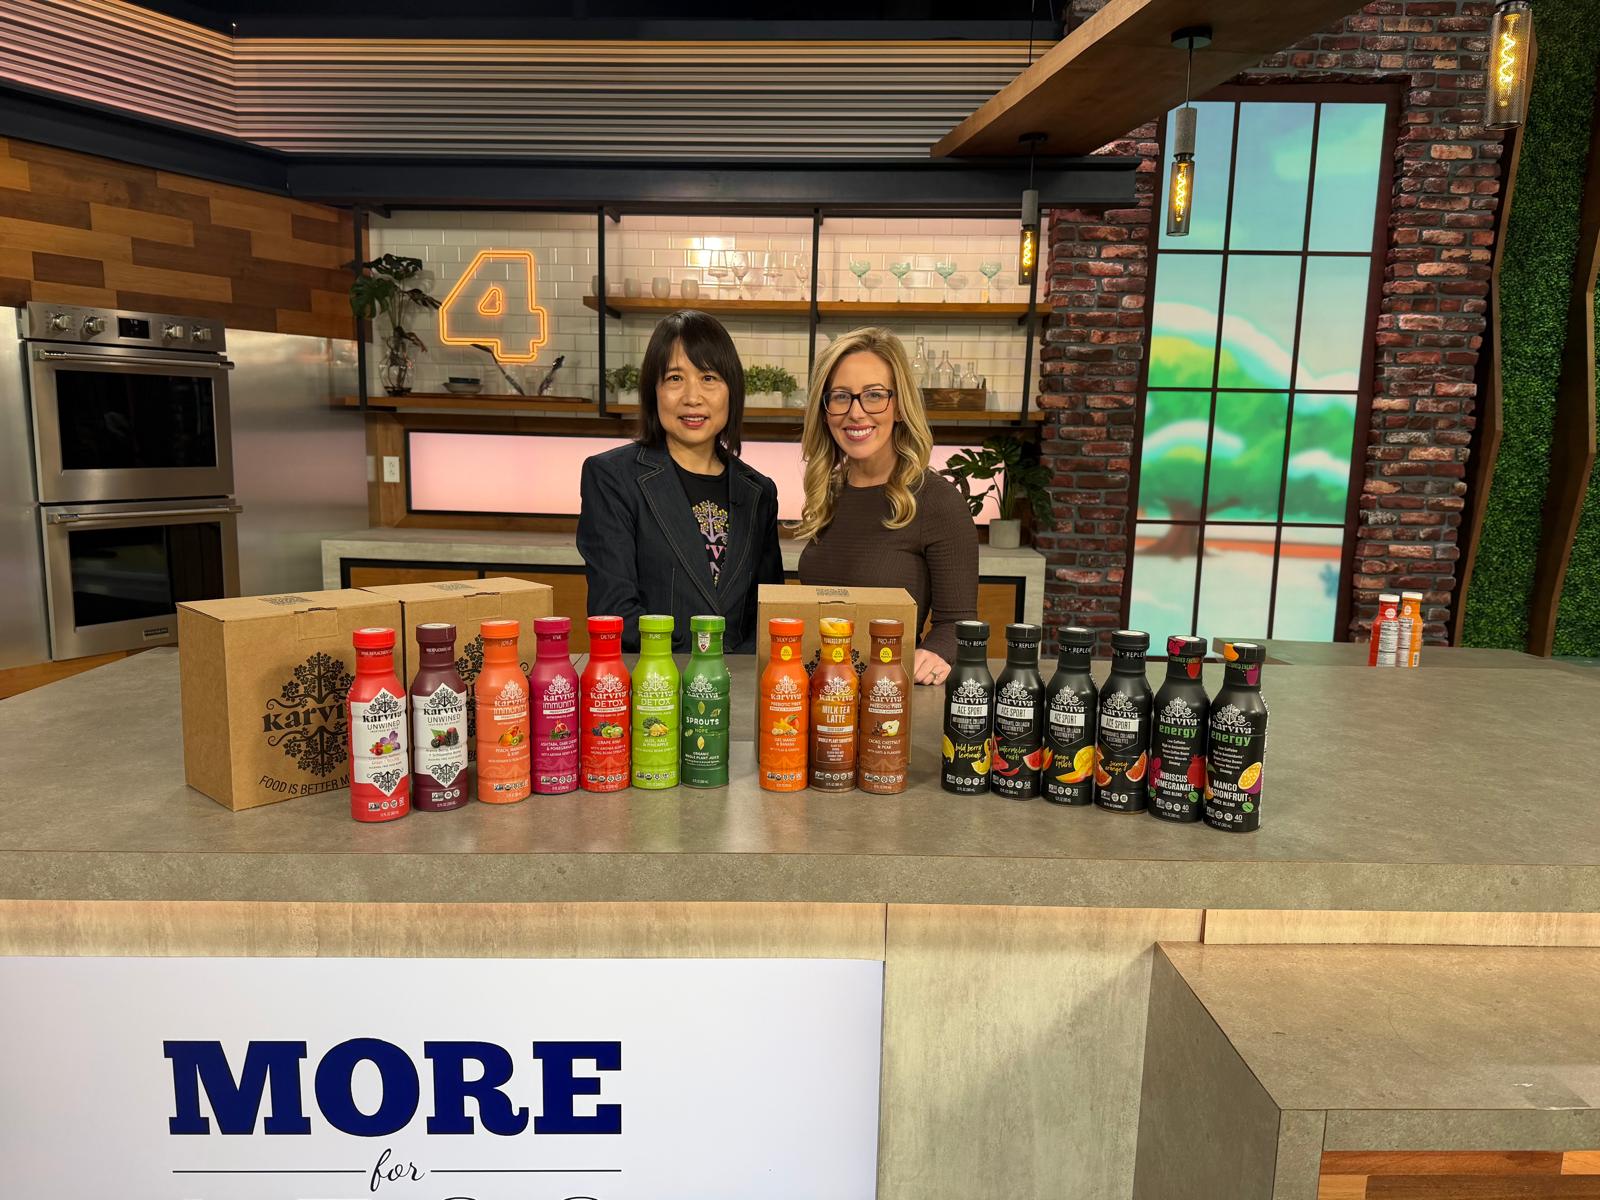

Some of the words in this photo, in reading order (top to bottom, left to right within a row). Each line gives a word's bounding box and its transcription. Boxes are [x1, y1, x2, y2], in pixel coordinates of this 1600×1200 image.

[439, 250, 547, 363] 4
[543, 691, 576, 701] karviva
[590, 691, 627, 700] karviva
[952, 695, 987, 703] karviva
[998, 695, 1033, 706] karviva
[594, 700, 624, 708] DETOX
[641, 698, 671, 706] DETOX
[1051, 703, 1085, 712] karviva
[424, 705, 462, 715] karviva
[822, 705, 838, 714] MILK
[840, 705, 850, 714] TEA
[957, 706, 967, 714] ACE
[967, 706, 983, 715] SPORT
[1001, 706, 1009, 716] ACE
[1010, 707, 1026, 717] SPORT
[1102, 707, 1138, 718] karviva
[262, 703, 346, 732] karvi
[362, 711, 402, 723] karviva
[428, 714, 460, 723] UNWINED
[686, 716, 720, 725] SPROUTS
[826, 714, 846, 723] LATTE
[1054, 714, 1062, 723] ACE
[1062, 715, 1077, 724] SPORT
[1160, 714, 1197, 726] karviva
[367, 720, 400, 730] UNWINED
[1106, 718, 1114, 727] ACE
[1114, 719, 1131, 728] SPORT
[1212, 720, 1252, 734] karviva
[1159, 724, 1197, 738] energy
[1210, 730, 1251, 747] energy
[1160, 771, 1188, 783] HIBISCUS
[259, 776, 287, 792] FOOD
[288, 784, 298, 794] IS
[301, 780, 338, 794] BETTER
[1154, 777, 1195, 791] POMEGRANATE
[1213, 779, 1238, 792] MANGO
[163, 1037, 622, 1137] MORE
[369, 1147, 425, 1193] for
